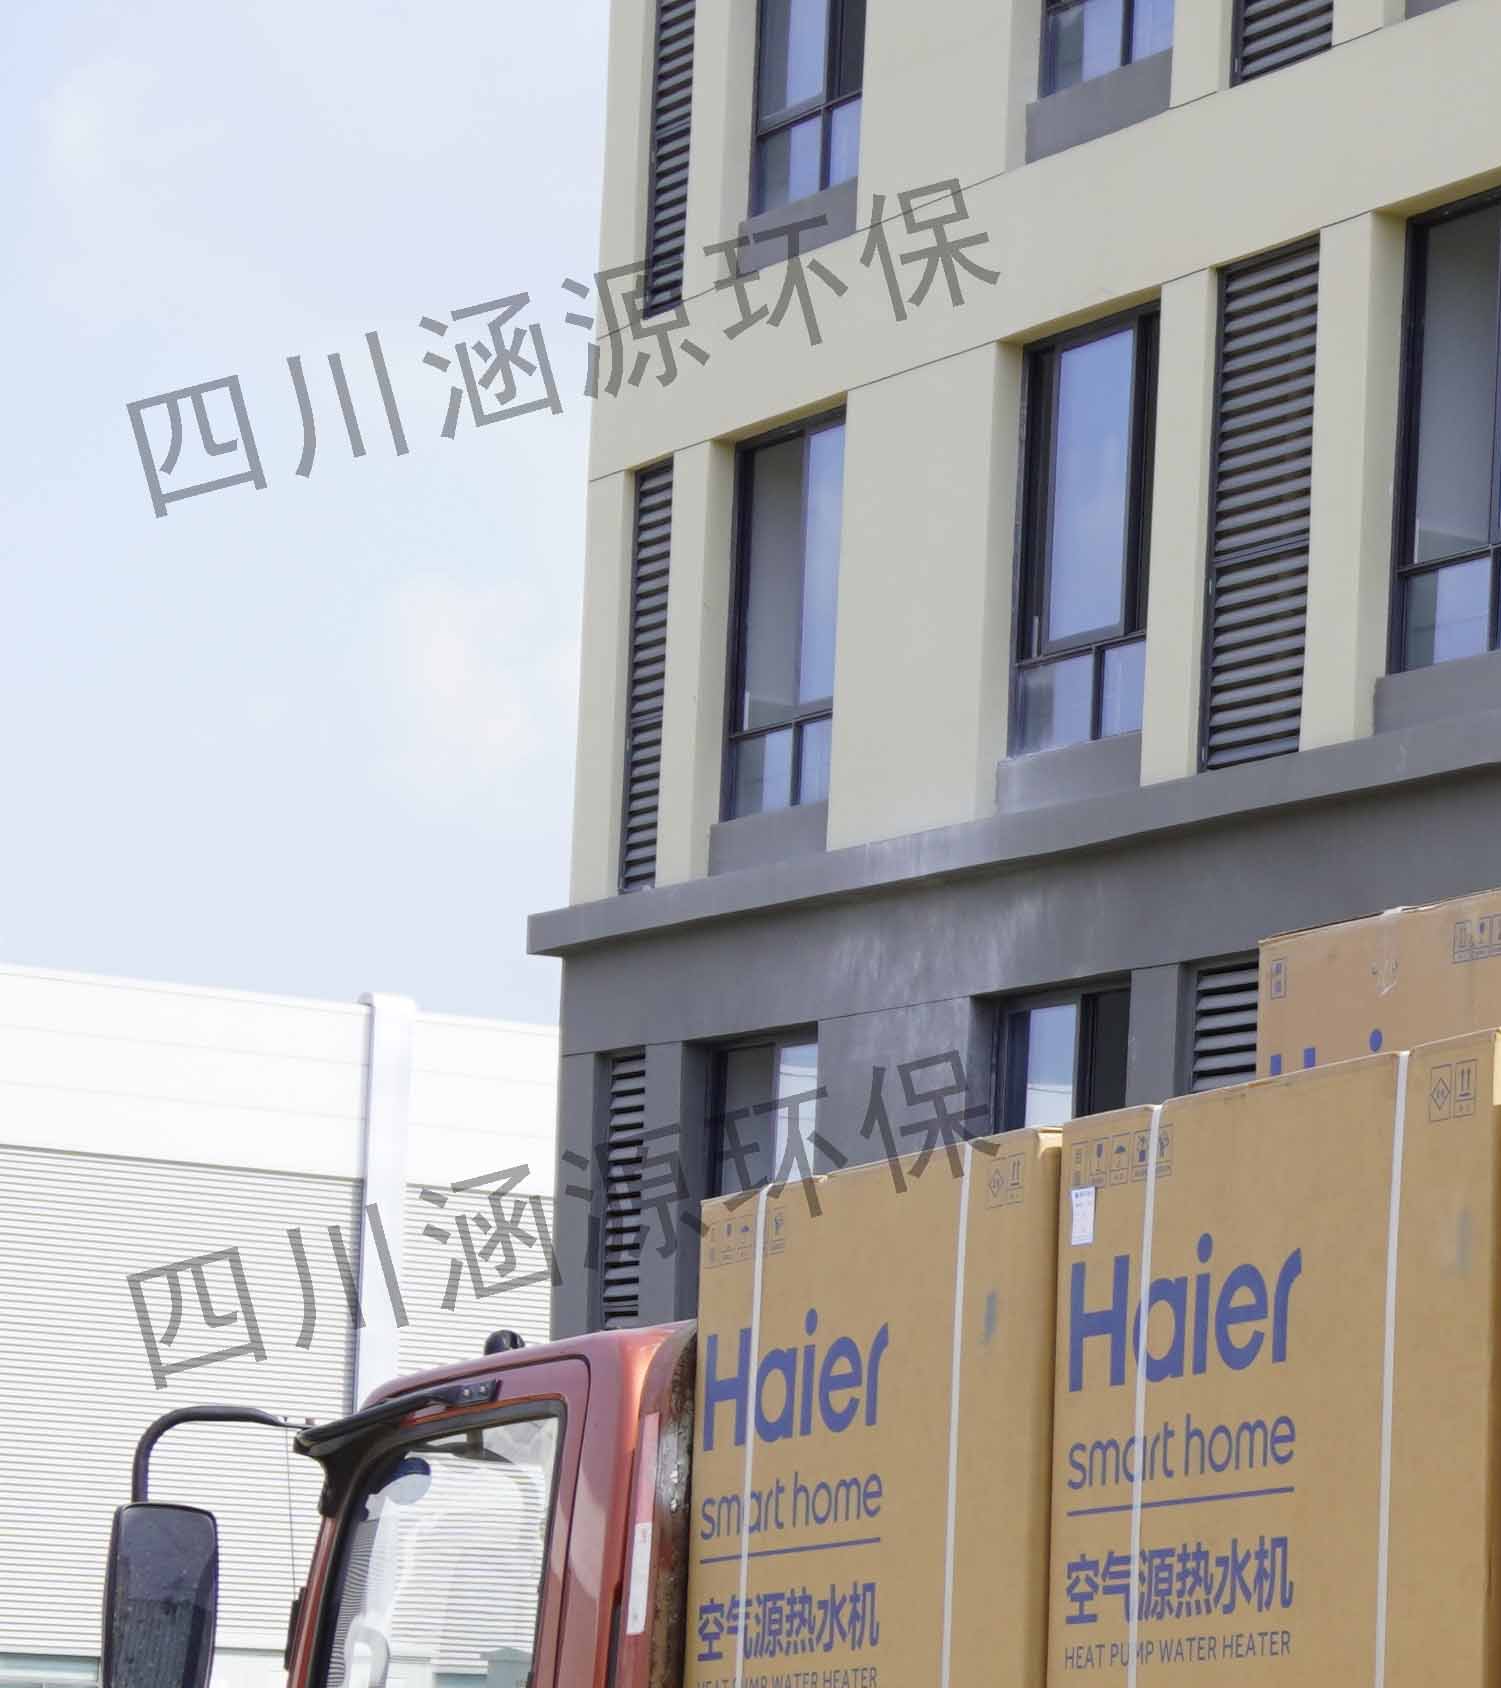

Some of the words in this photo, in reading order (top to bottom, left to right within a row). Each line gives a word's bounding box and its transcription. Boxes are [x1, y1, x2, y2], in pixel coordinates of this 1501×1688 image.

[1069, 1233, 1302, 1393] Haier
[702, 1307, 889, 1452] Haier
[1067, 1423, 1174, 1492] smart
[1186, 1413, 1295, 1476] home
[700, 1480, 785, 1543] smart
[793, 1472, 883, 1532] home
[1066, 1535, 1293, 1625] 空气源热水机
[697, 1581, 880, 1663] 空气源热水机
[1065, 1643, 1103, 1669] HEAT
[1110, 1639, 1154, 1666] PUMP
[1160, 1635, 1217, 1663] WATER
[1223, 1631, 1291, 1659] HEATER
